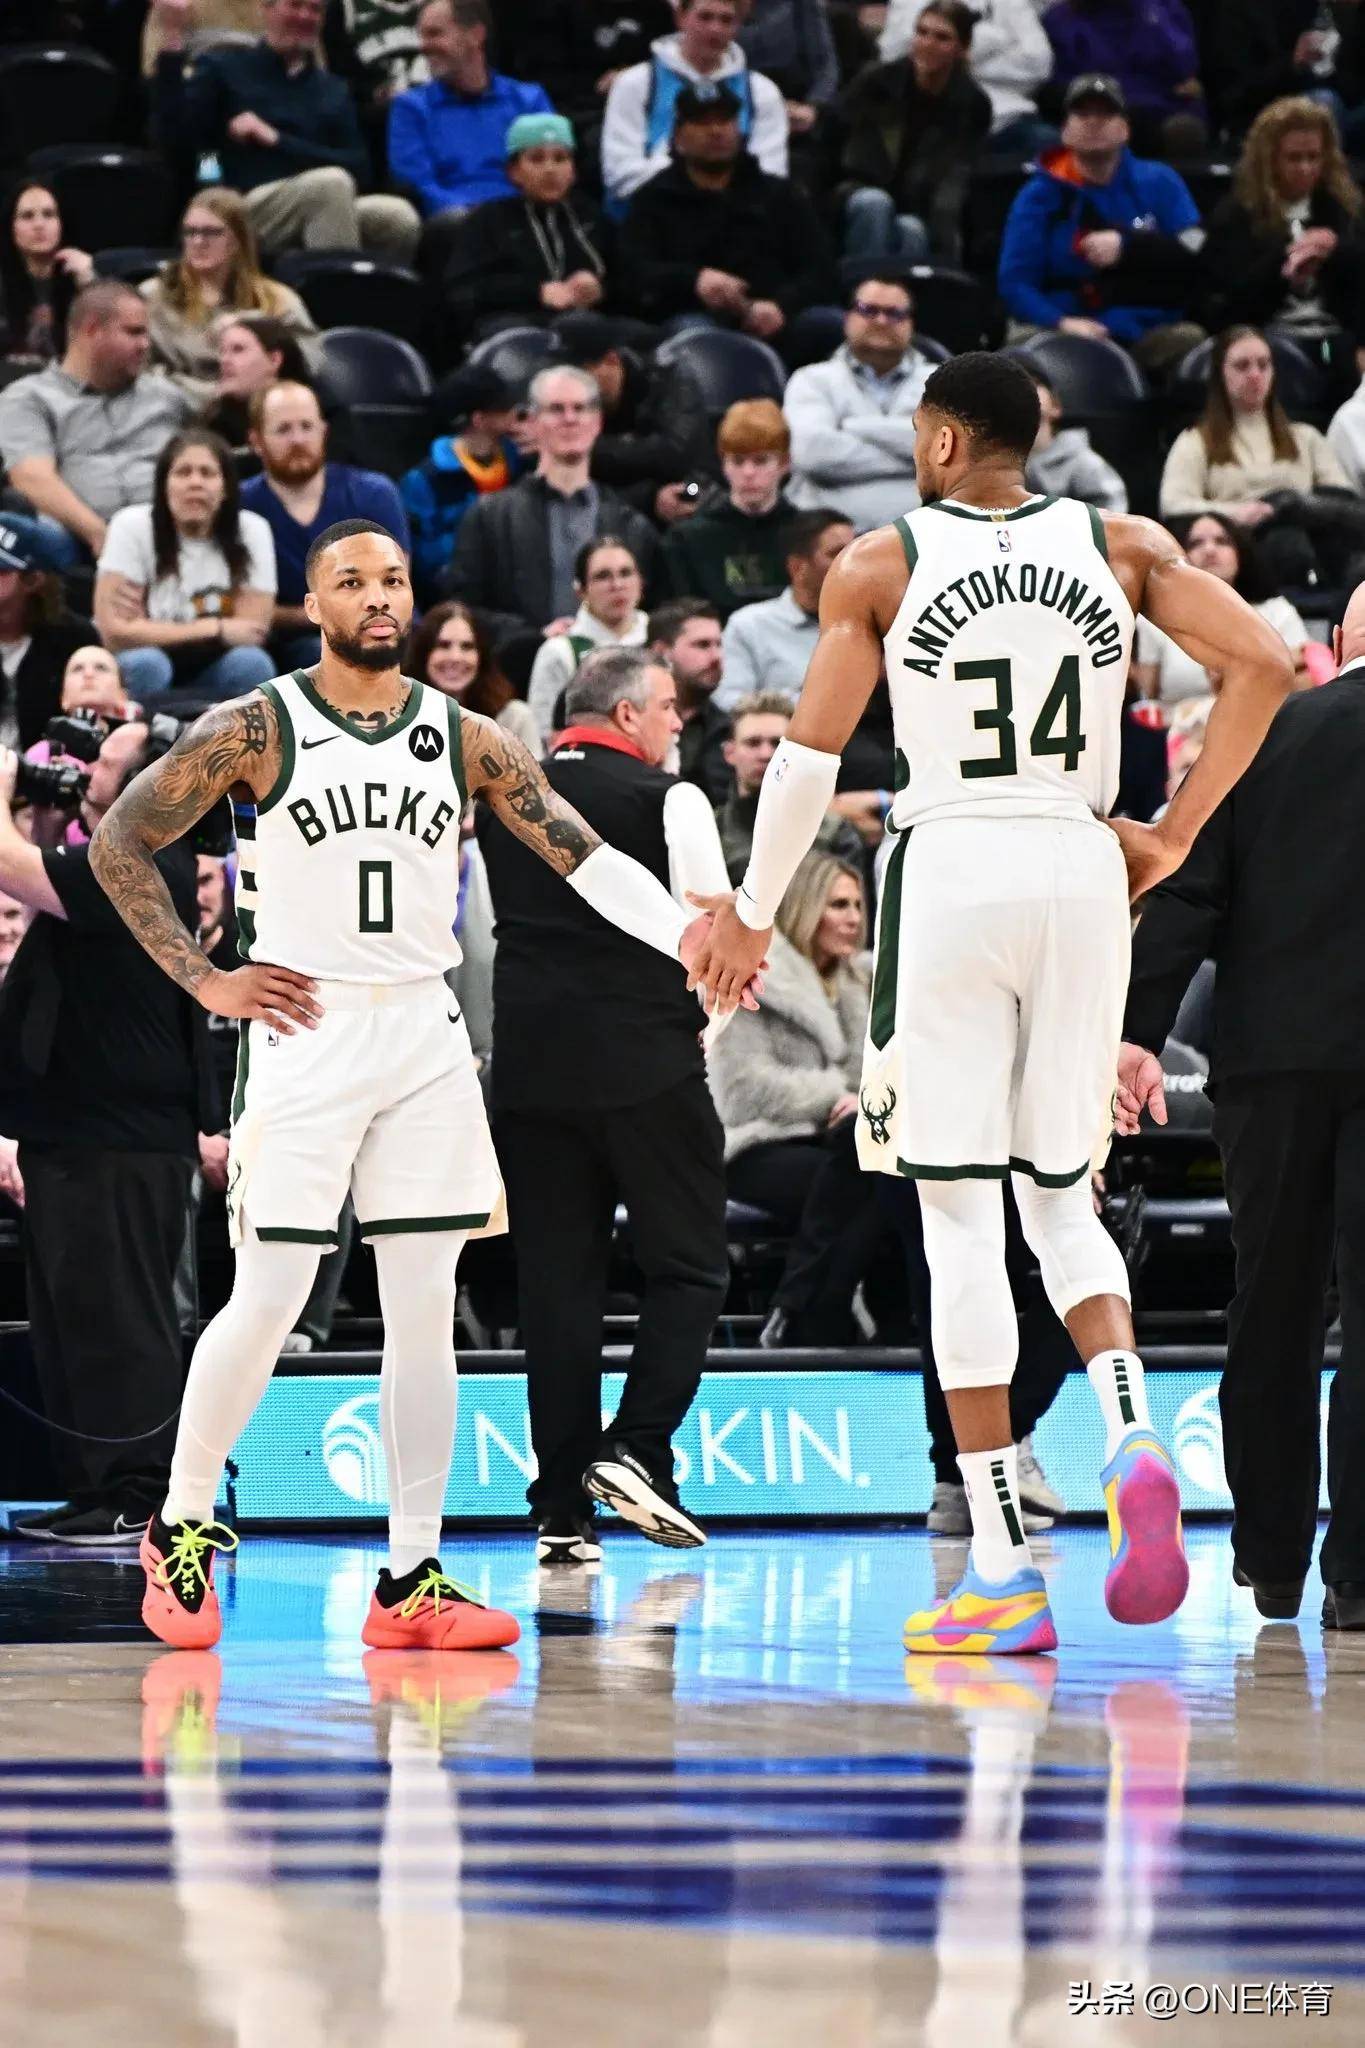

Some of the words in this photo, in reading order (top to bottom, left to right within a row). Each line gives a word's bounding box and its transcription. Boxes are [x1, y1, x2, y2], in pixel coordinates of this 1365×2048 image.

[903, 563, 1123, 680] ANTETOKOUNMPO
[954, 654, 1087, 779] 34
[286, 782, 455, 850] BUCKS
[358, 860, 393, 934] 0
